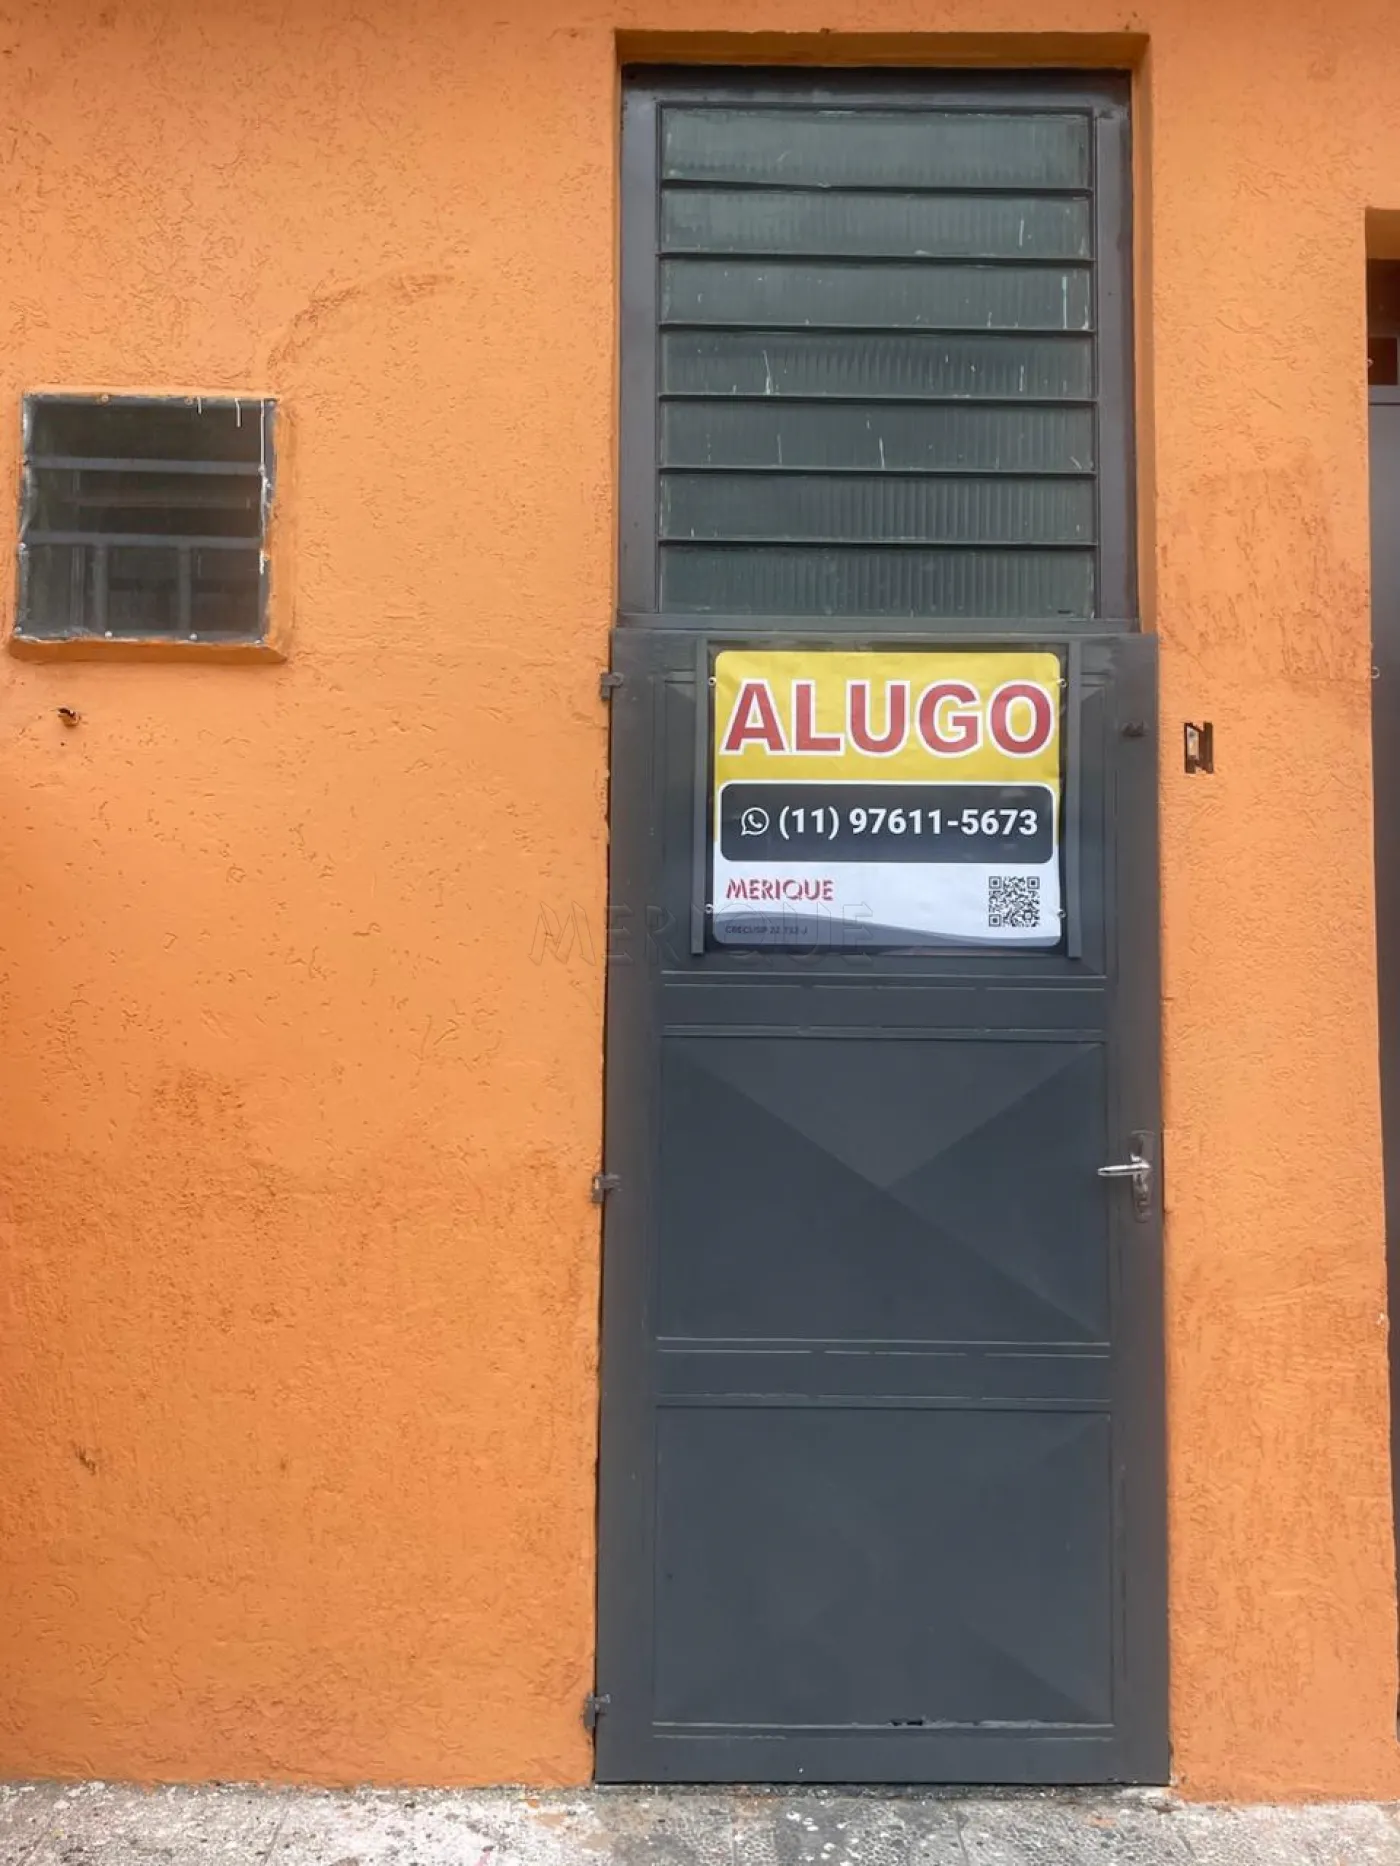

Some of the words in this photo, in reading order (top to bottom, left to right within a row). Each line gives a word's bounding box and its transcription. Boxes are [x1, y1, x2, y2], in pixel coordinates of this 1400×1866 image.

[720, 678, 1056, 758] ALUGO
[779, 806, 840, 840] (11)
[849, 808, 1038, 836] 97611-5673
[726, 878, 834, 901] MERIQUE
